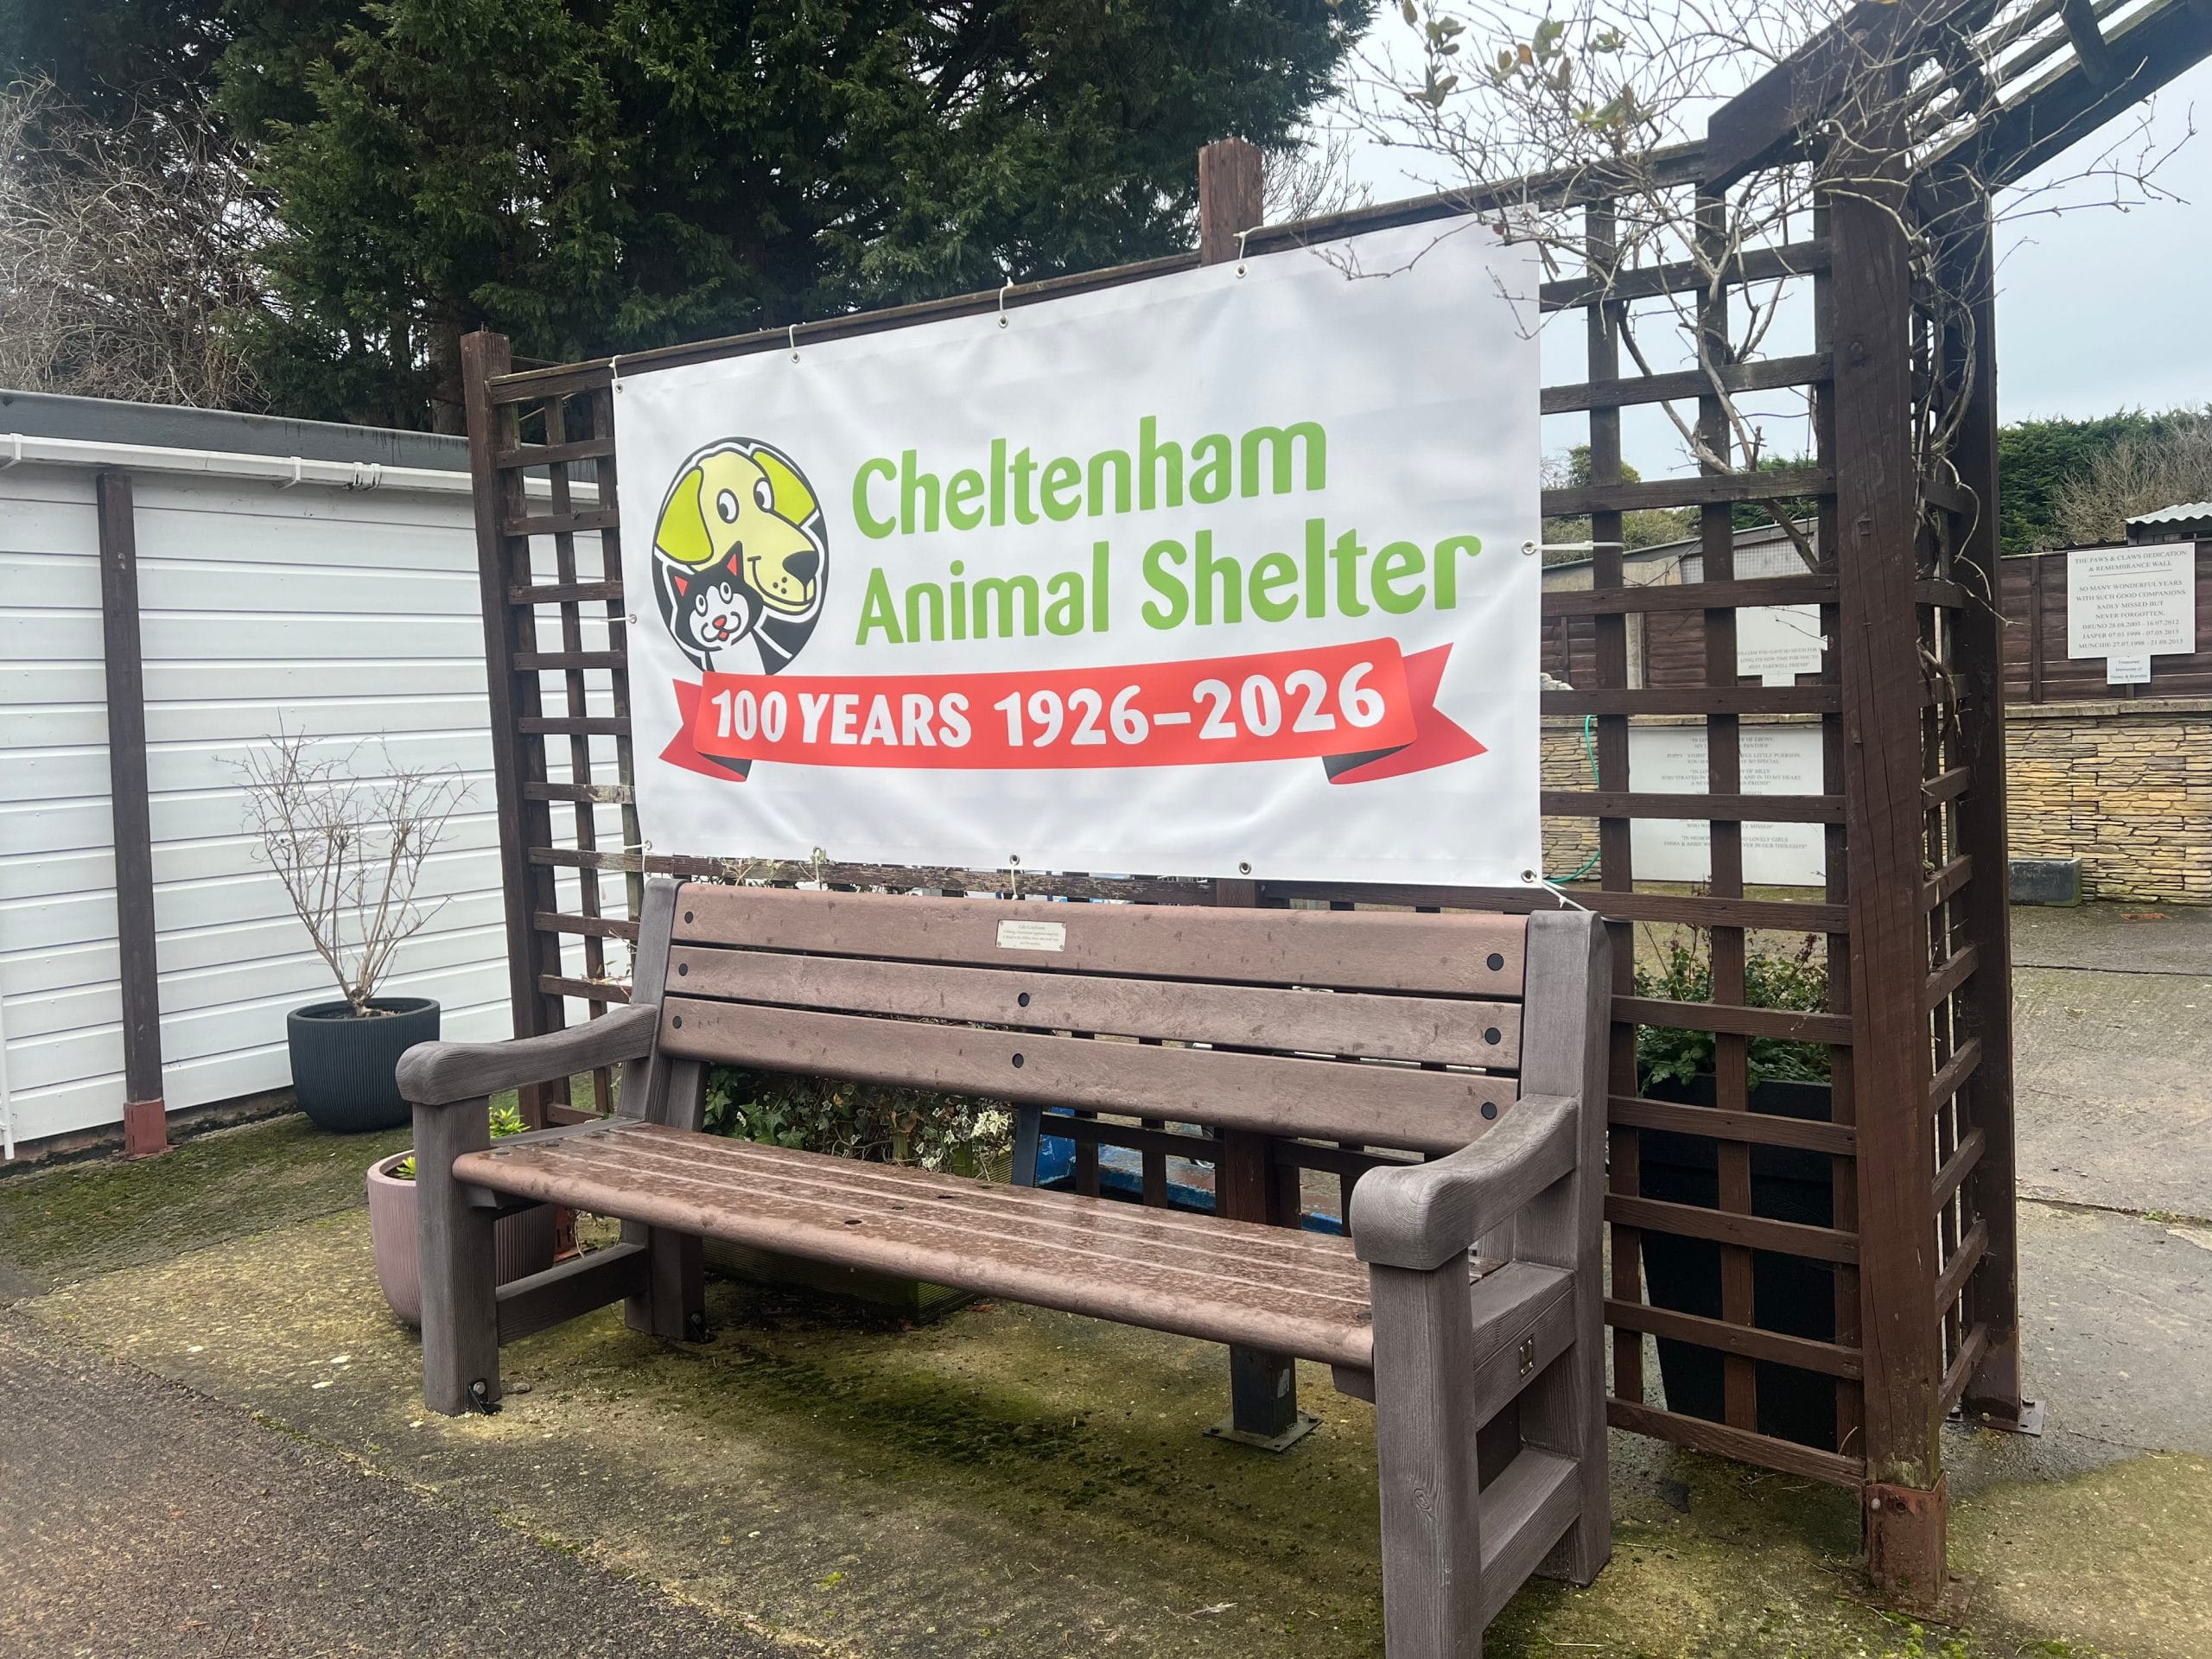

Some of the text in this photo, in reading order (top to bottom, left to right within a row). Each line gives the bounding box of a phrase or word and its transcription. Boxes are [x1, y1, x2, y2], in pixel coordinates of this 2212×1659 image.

[853, 416, 1326, 539] Cheltenham
[2143, 550, 2187, 559] DEDICATION
[2095, 562, 2151, 571] REMEMBRANCE
[856, 519, 1482, 645] Animal Shelter
[2113, 581, 2158, 589] WONDERFUL
[2139, 589, 2186, 598] COMPANIONS
[710, 690, 788, 743] 100
[798, 692, 972, 748] YEARS
